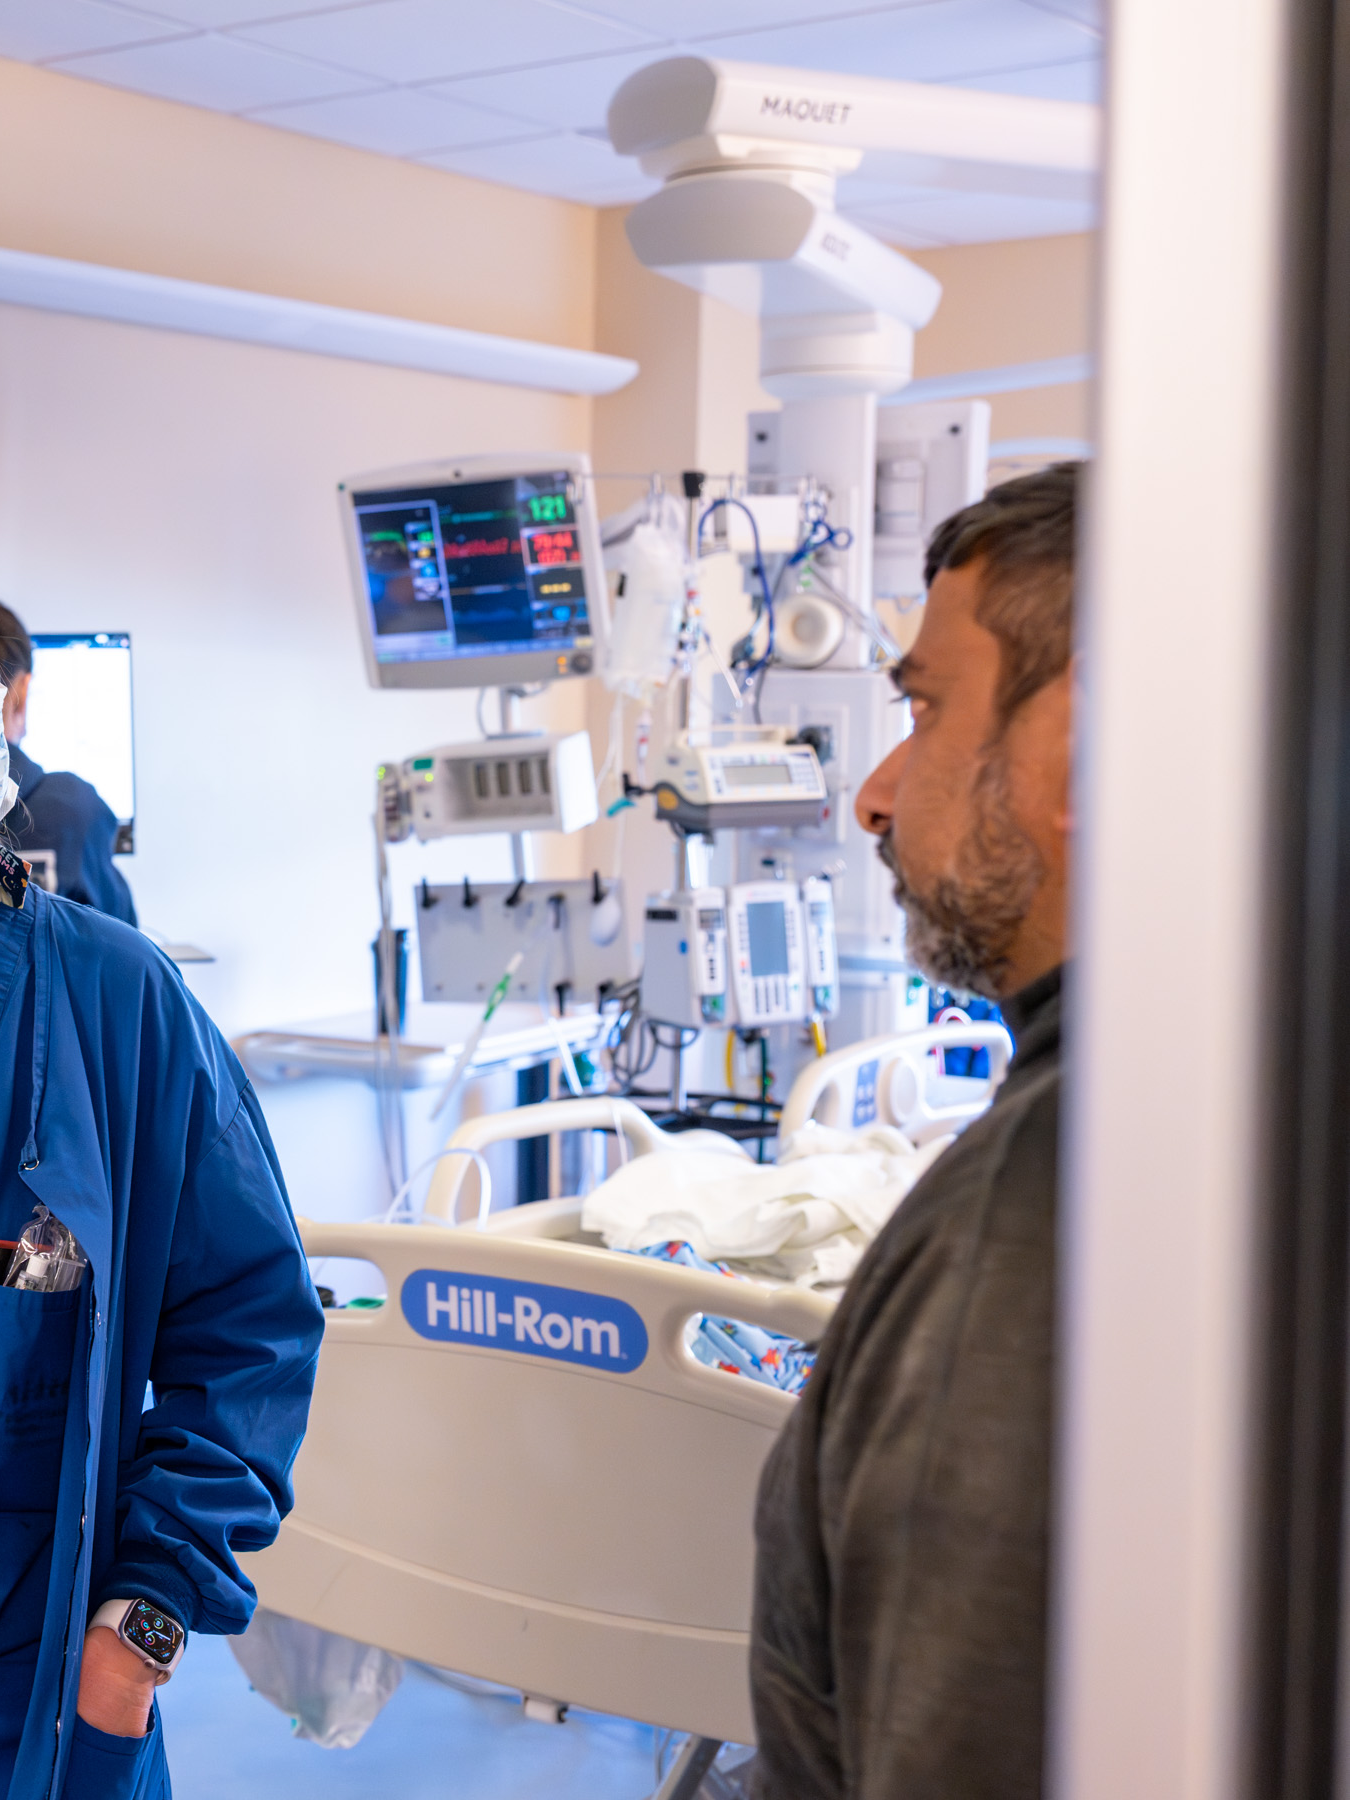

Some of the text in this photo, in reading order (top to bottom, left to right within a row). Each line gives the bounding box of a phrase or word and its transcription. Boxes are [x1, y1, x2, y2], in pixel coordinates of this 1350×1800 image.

[760, 96, 853, 126] MAQUET
[529, 494, 567, 521] 121
[426, 1281, 621, 1359] Hill-Rom
